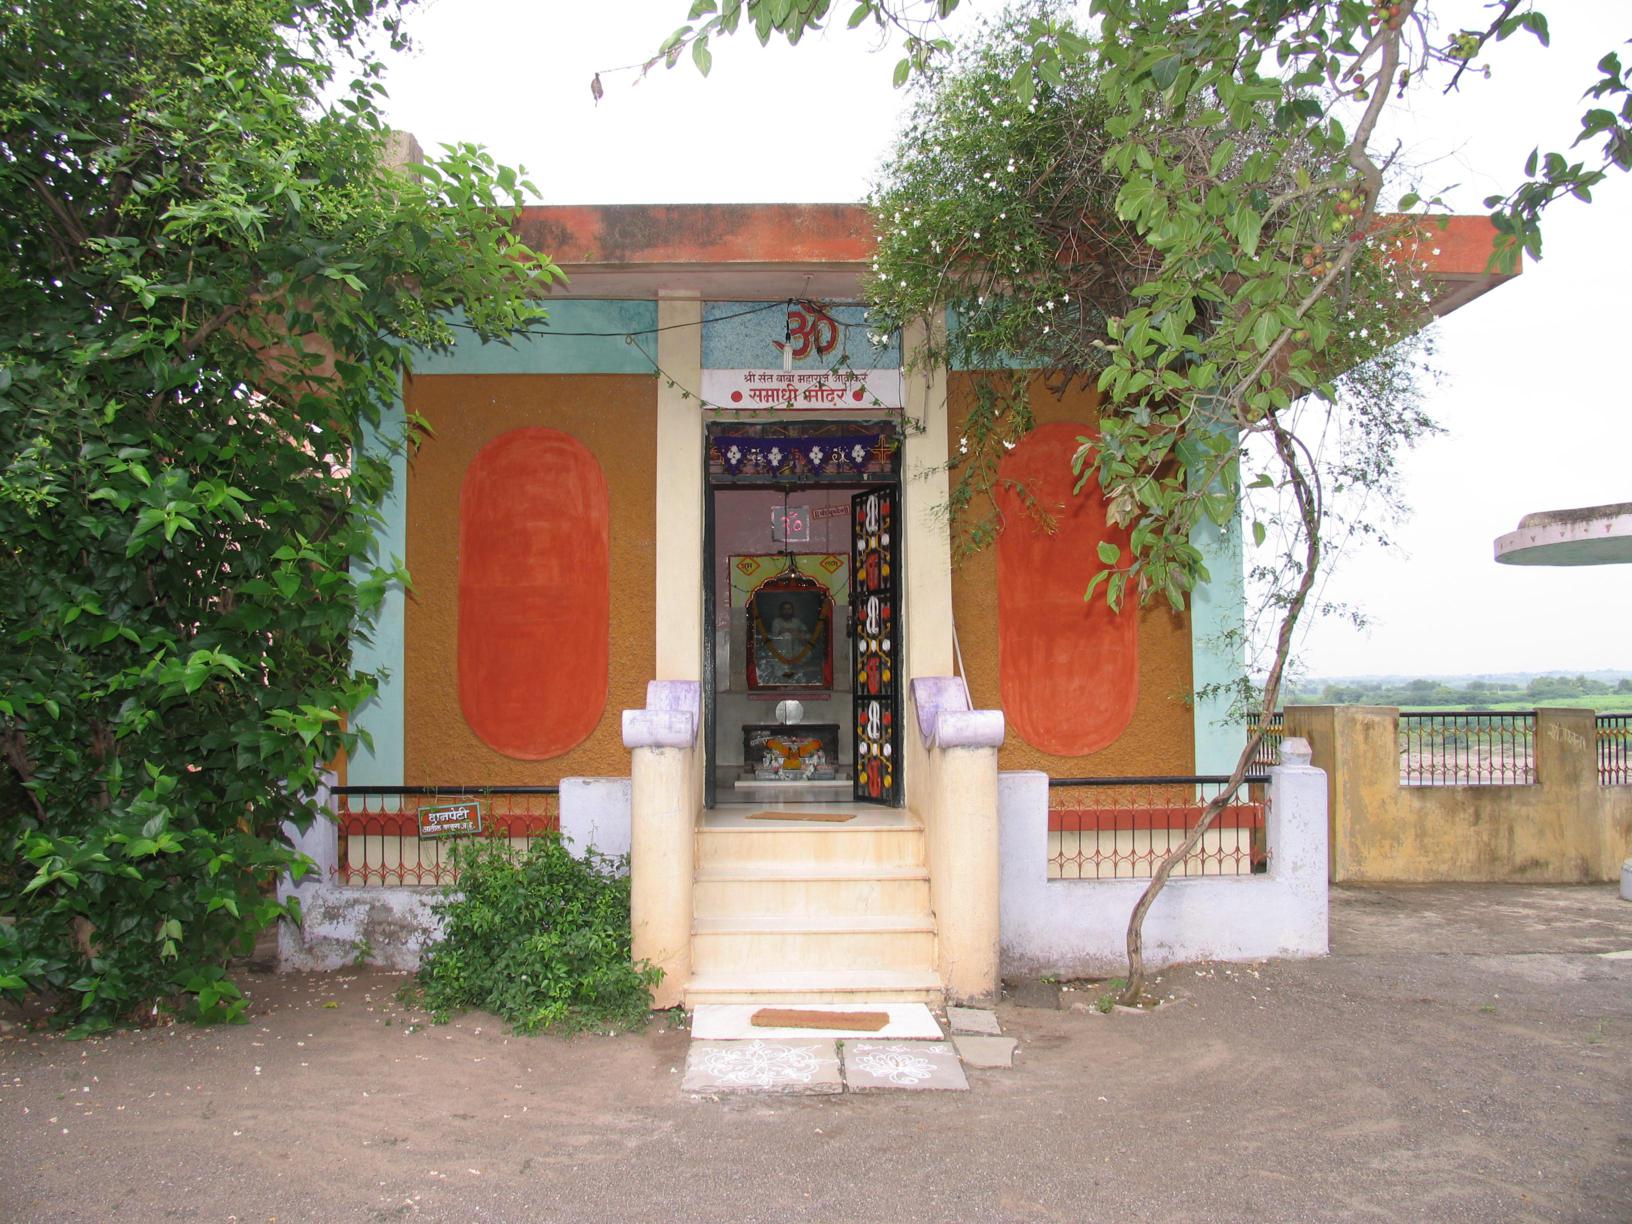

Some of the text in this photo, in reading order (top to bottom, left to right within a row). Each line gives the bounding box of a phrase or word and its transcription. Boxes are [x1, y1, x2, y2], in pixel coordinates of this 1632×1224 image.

[743, 371, 756, 384] श्री
[758, 371, 773, 384] संत
[776, 373, 795, 384] बाबा
[797, 373, 830, 384] महाराज
[749, 383, 799, 403] समाधी
[428, 807, 470, 824] दानपेटी
